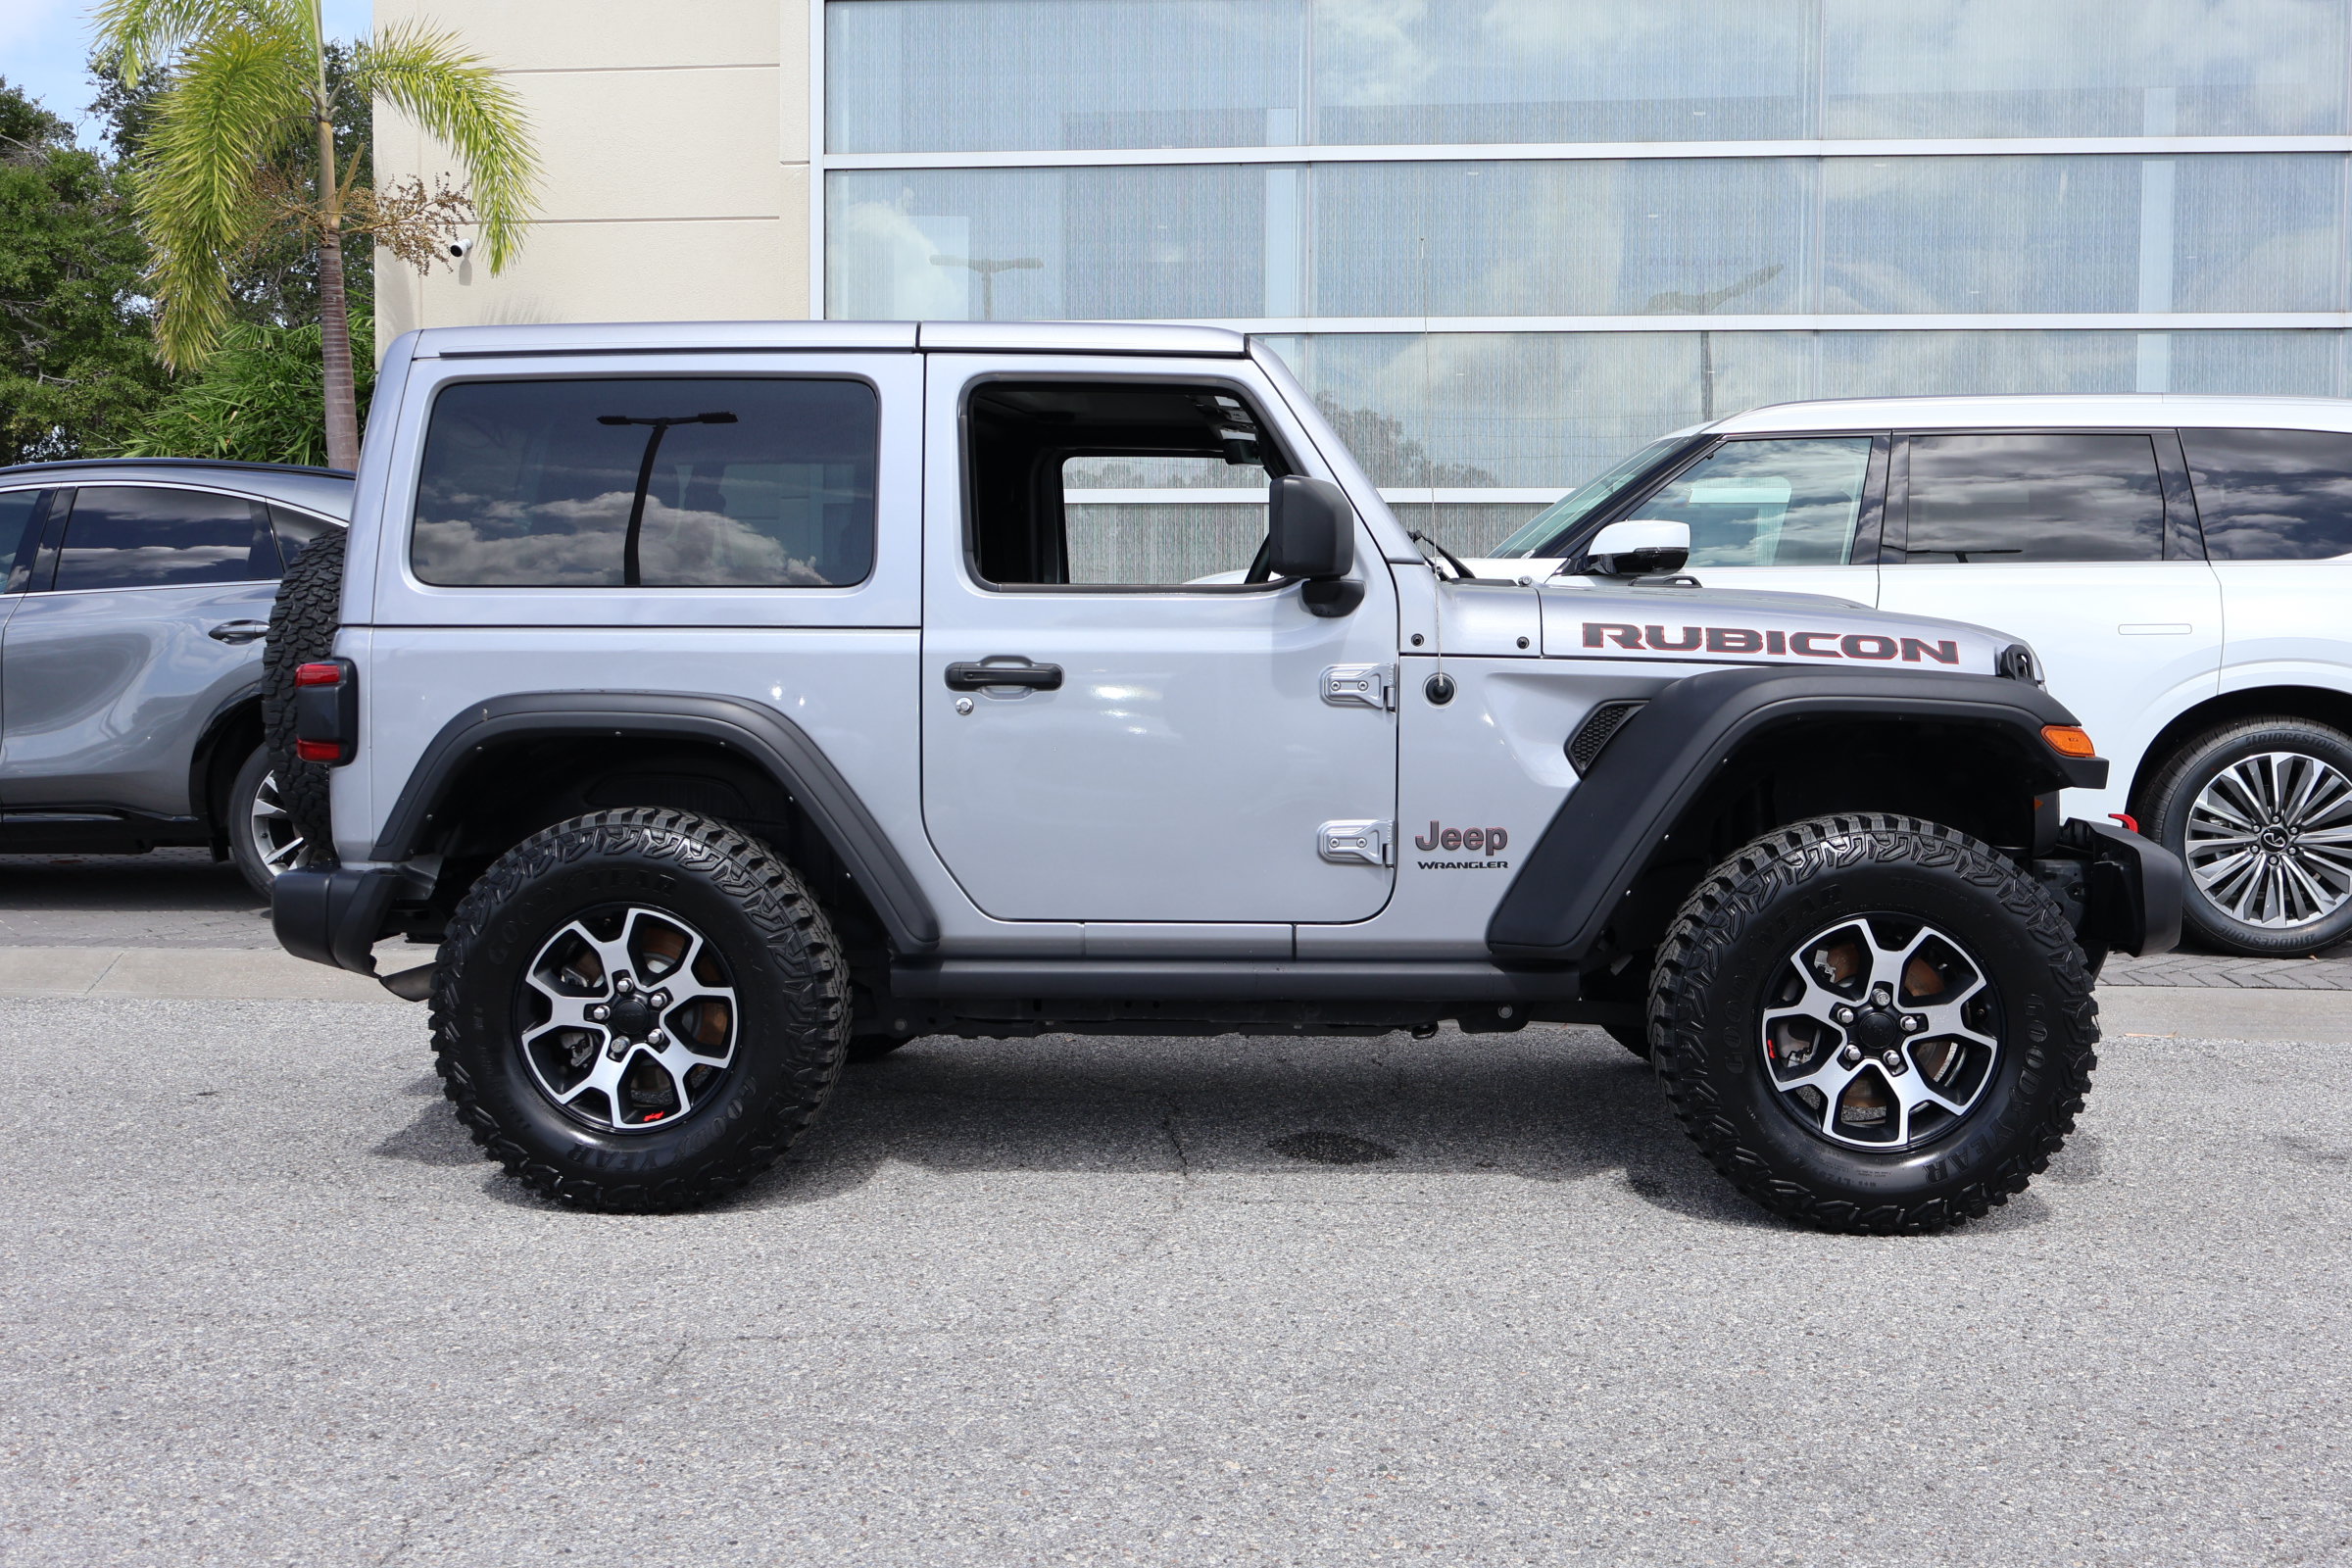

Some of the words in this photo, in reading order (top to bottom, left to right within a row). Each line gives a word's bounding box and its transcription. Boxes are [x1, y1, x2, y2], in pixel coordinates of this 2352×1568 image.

[1582, 622, 1960, 665] RUBICON
[1414, 820, 1508, 857] Jeep
[1417, 861, 1509, 870] WRANGLER
